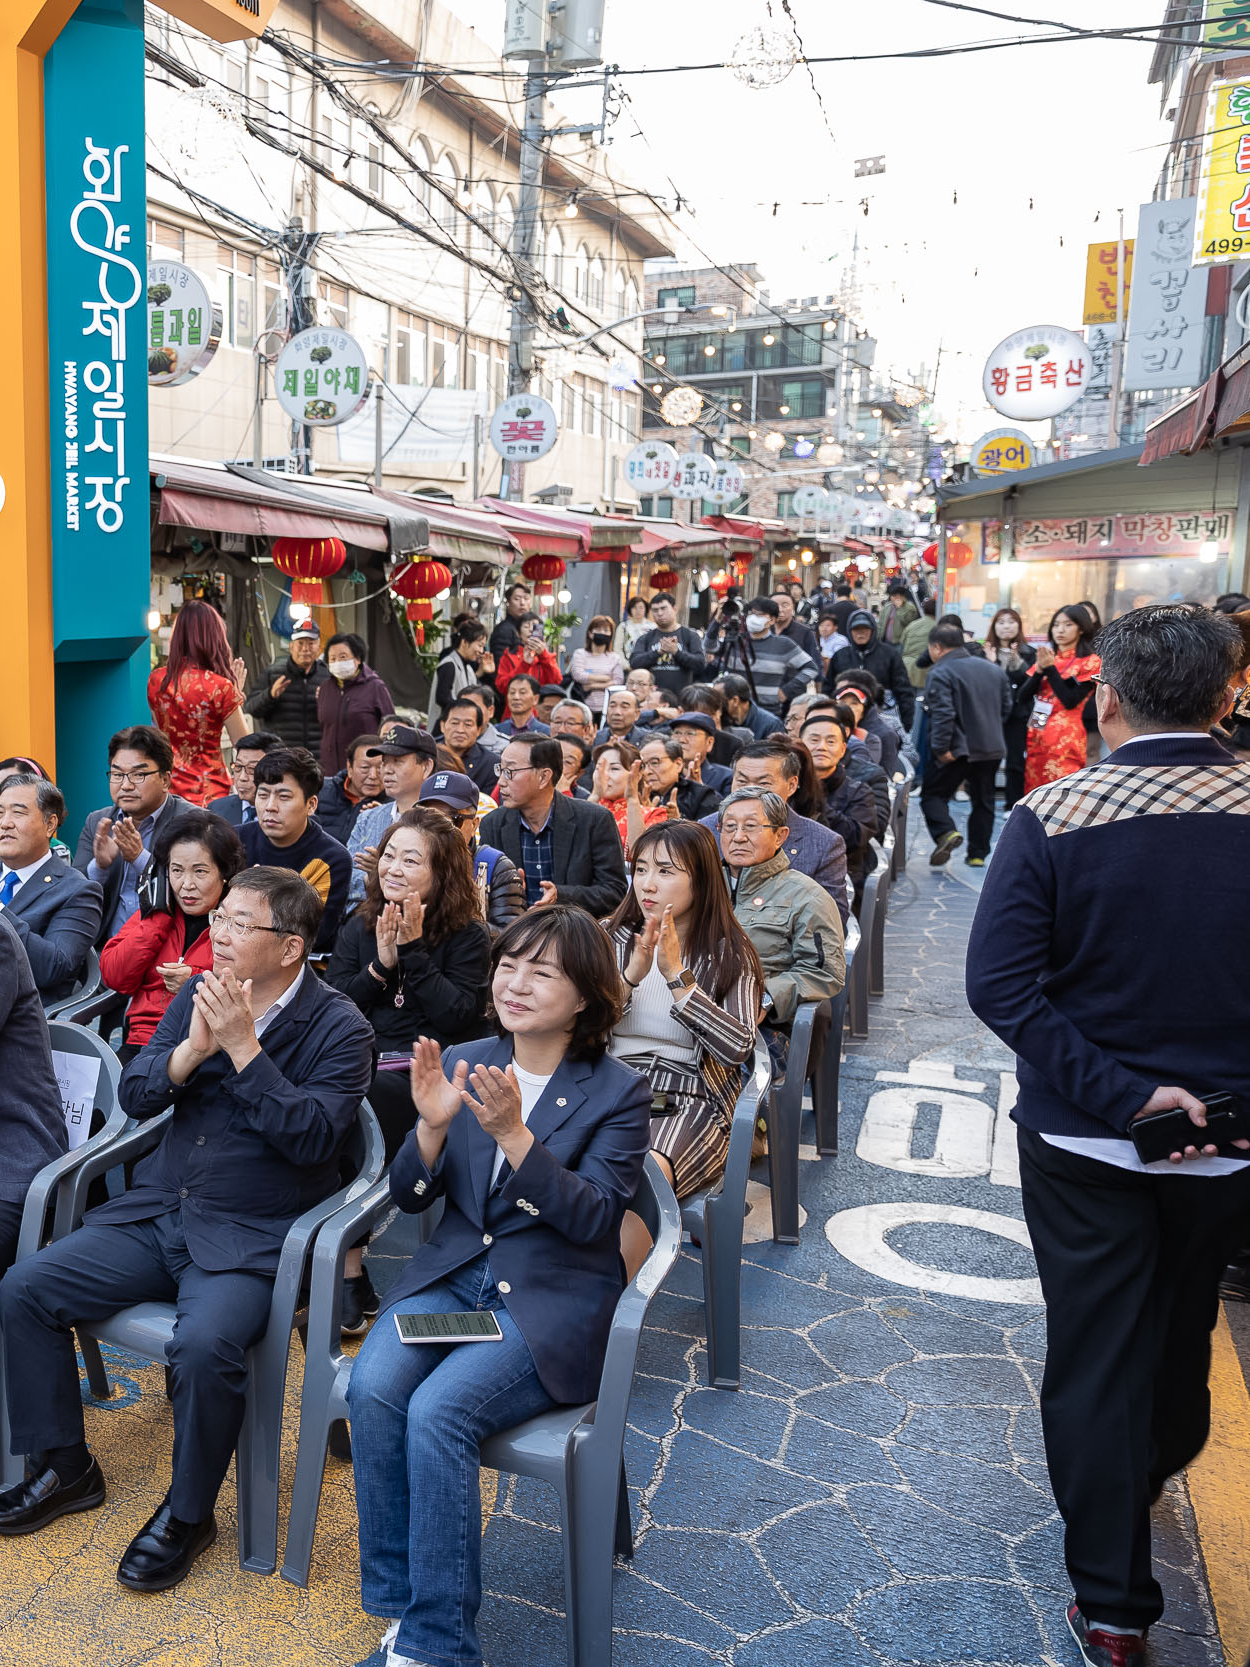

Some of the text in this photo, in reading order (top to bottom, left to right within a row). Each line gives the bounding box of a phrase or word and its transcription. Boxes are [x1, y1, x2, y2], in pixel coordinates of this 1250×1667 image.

[70, 136, 143, 533] 화양제일시장
[283, 366, 361, 397] 제일야채
[991, 358, 1085, 396] 황금축산
[500, 420, 547, 443] 꽃
[65, 441, 78, 470] JEIL
[981, 444, 1025, 467] 광어
[66, 472, 79, 531] MARKET
[1123, 514, 1230, 543] 막창판매
